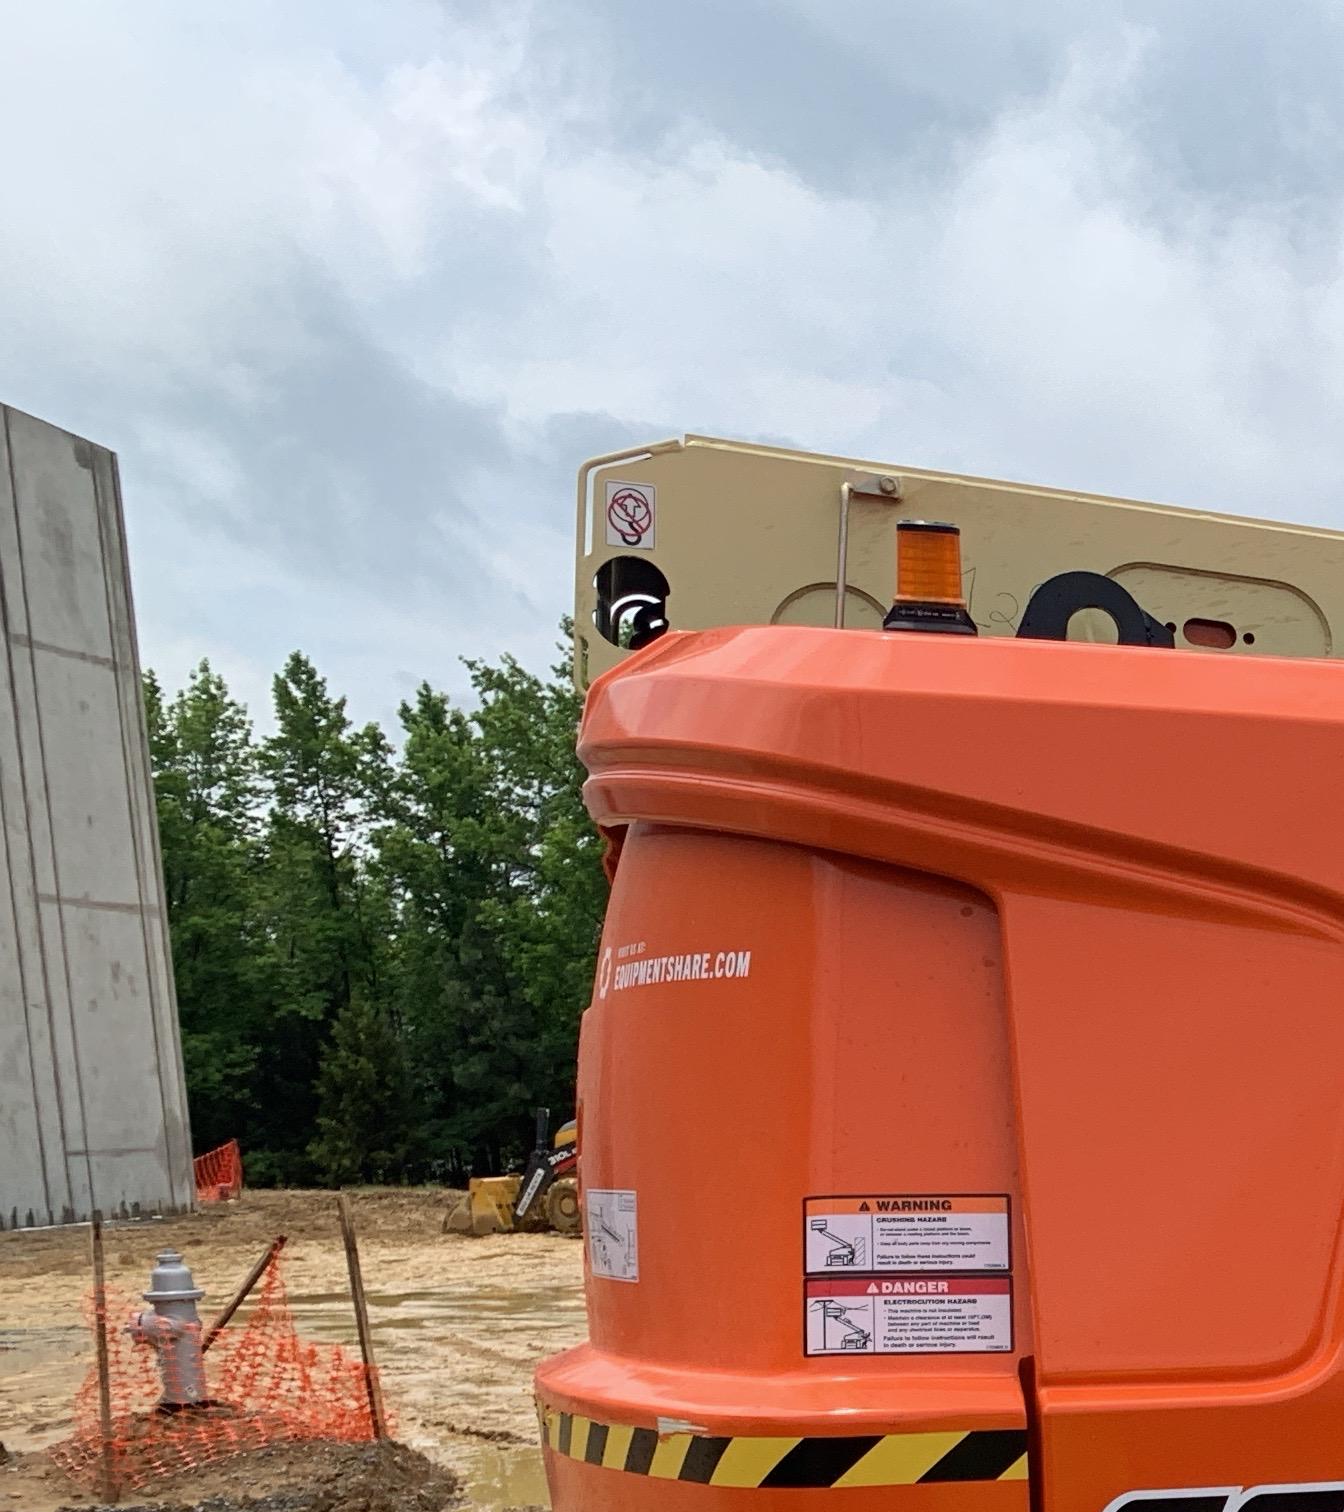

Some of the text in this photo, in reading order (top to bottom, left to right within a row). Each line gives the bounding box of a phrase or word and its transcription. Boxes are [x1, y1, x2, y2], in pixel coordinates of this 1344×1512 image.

[613, 951, 751, 991] EQUIPMENTSHARE.COM
[876, 1199, 952, 1212] WARNING
[881, 1281, 949, 1294] DANGER
